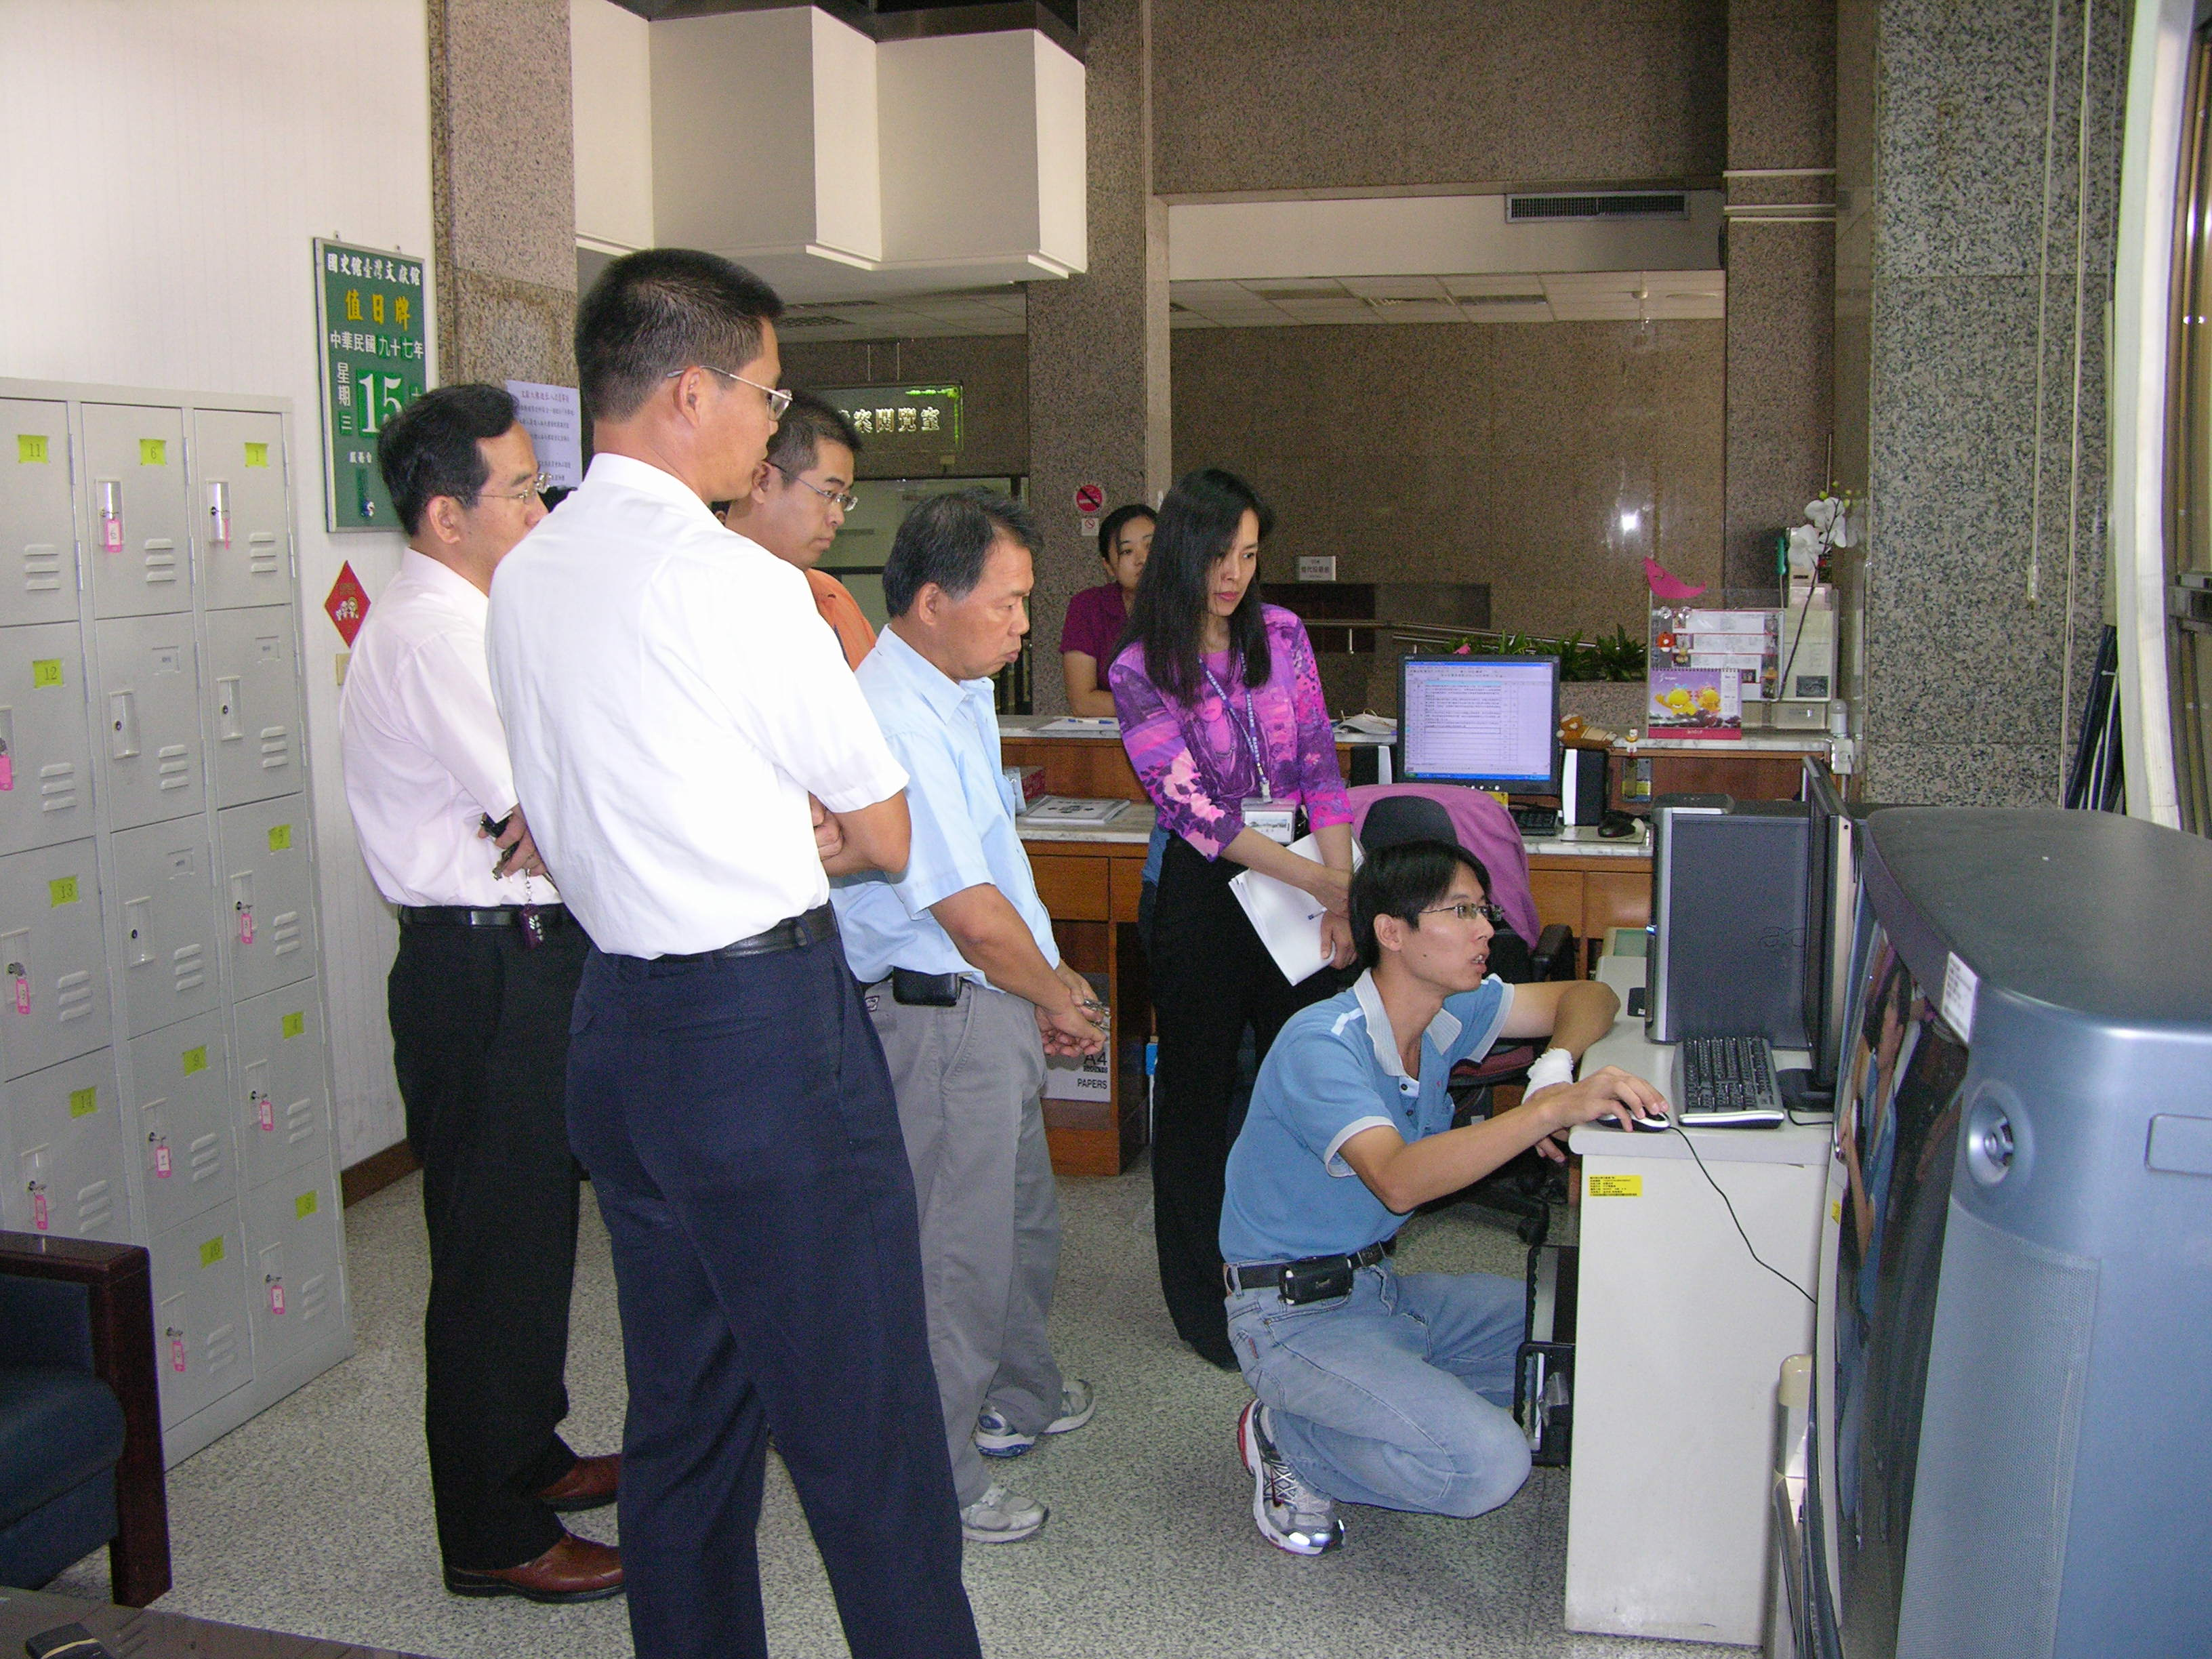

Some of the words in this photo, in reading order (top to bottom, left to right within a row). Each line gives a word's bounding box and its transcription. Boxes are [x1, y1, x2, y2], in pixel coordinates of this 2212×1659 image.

[346, 288, 411, 331] 值日牌
[330, 330, 424, 359] 中華民國九十七年
[359, 373, 403, 432] 15
[838, 407, 940, 433] 案閱覽室
[29, 443, 41, 457] 11
[150, 443, 157, 459] 6
[45, 666, 58, 680] 12
[61, 883, 73, 899] 13
[1084, 1051, 1108, 1066] A4
[1077, 1078, 1108, 1090] PAPERS
